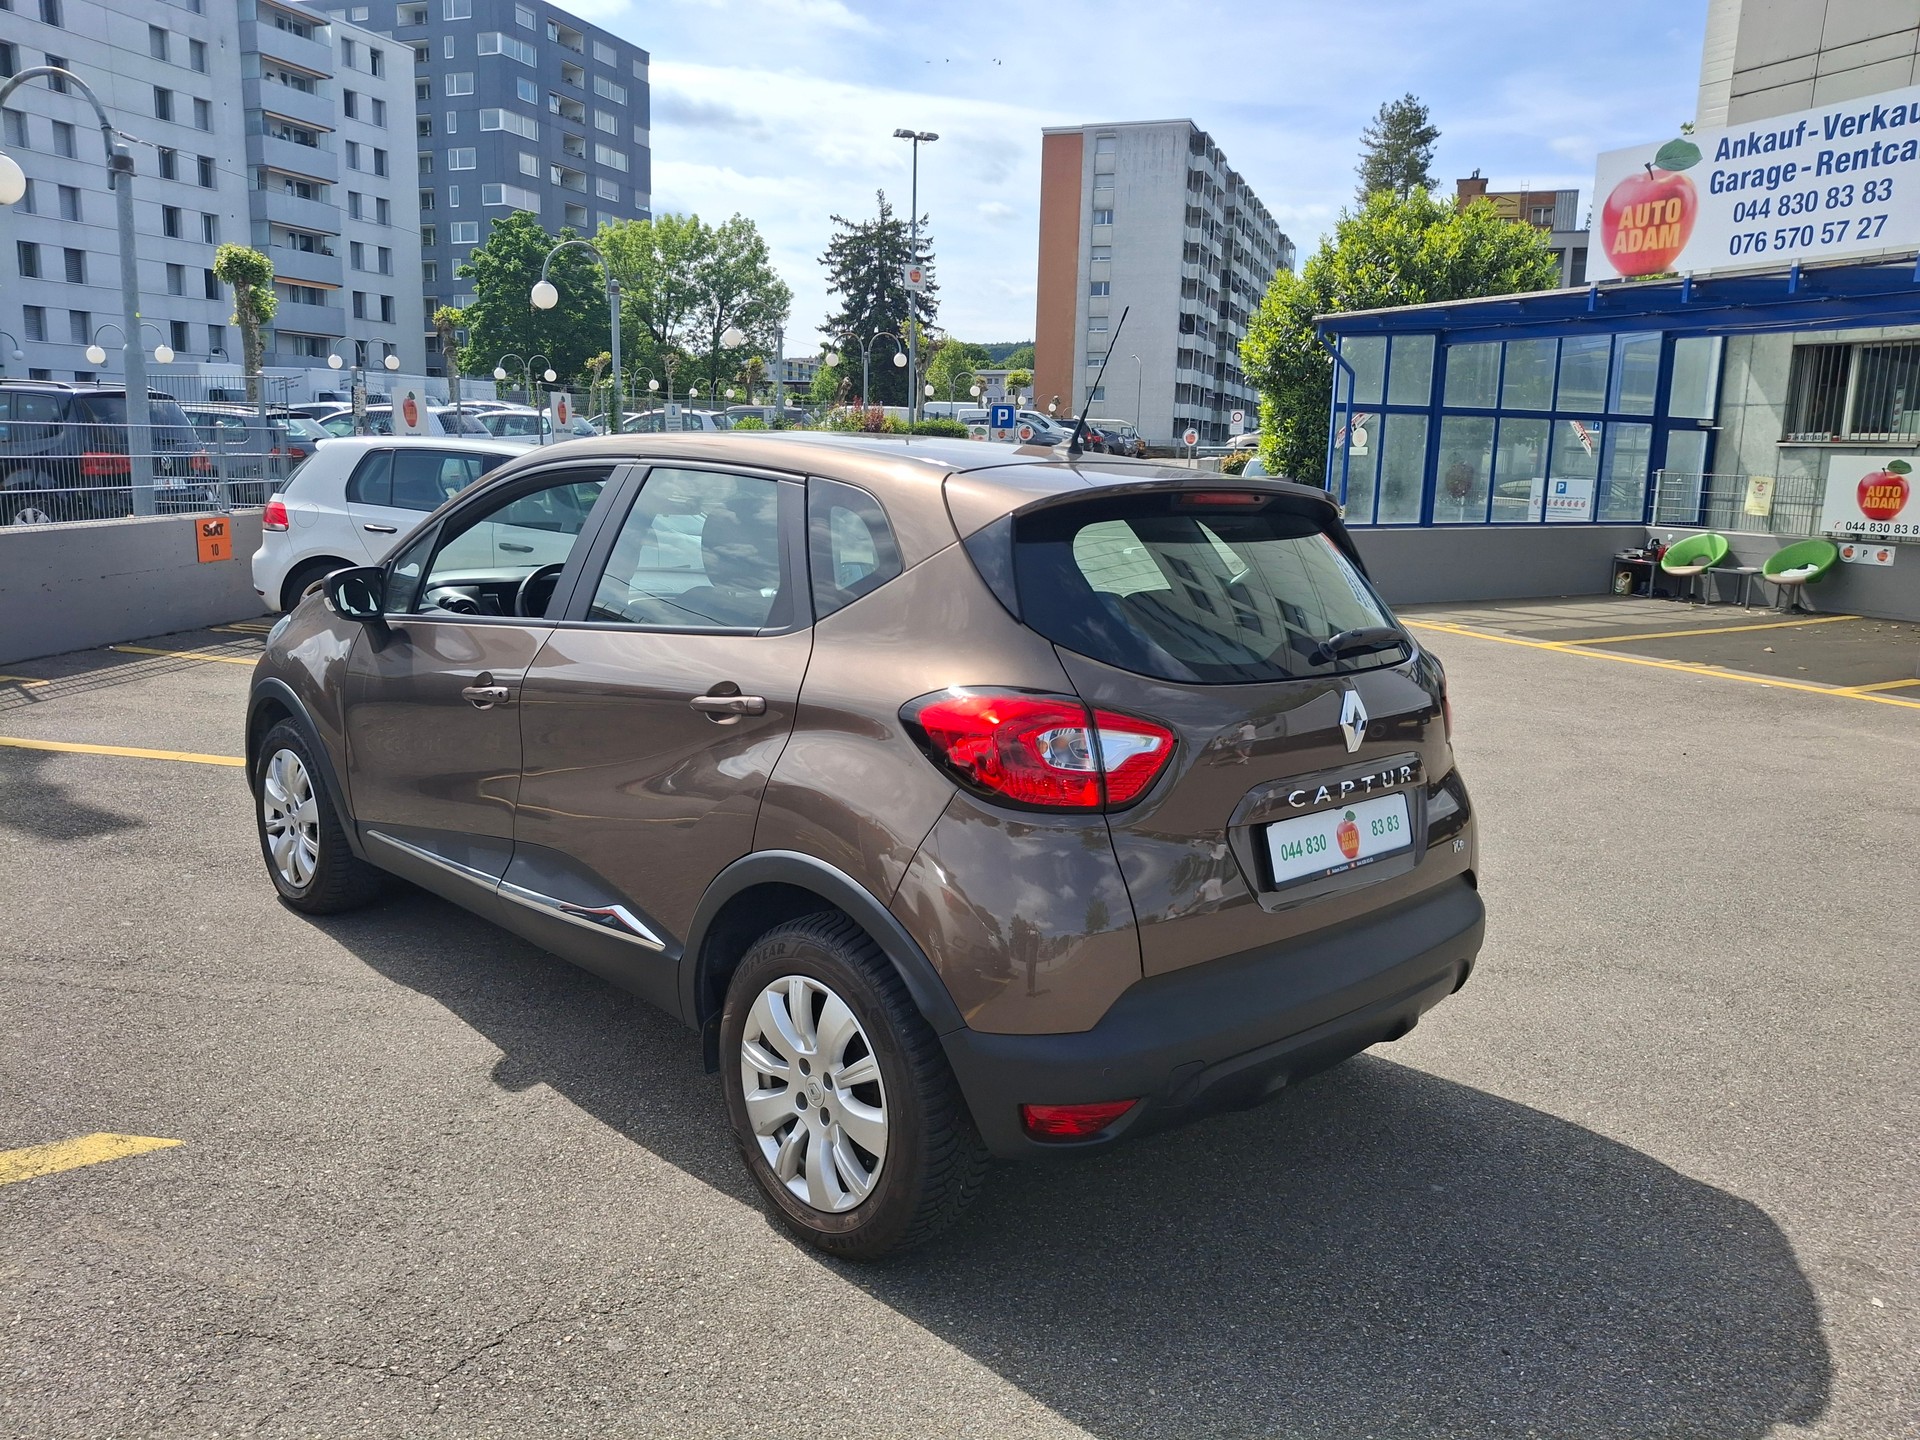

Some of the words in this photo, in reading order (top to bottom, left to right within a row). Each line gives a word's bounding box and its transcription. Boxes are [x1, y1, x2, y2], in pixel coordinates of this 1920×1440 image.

[1733, 197, 1771, 223] 044
[1777, 190, 1819, 217] 830
[1825, 184, 1855, 210] 83
[1861, 178, 1893, 204] 83
[1618, 197, 1682, 231] AUTO
[1611, 223, 1681, 255] ADAM
[1729, 231, 1767, 256] 076
[1773, 224, 1814, 250] 570
[1820, 219, 1850, 244] 57
[1856, 214, 1889, 240] 27
[997, 409, 1009, 426] P
[1557, 483, 1565, 492] P
[1866, 486, 1902, 498] AUTO
[1862, 497, 1900, 509] ADAM
[203, 523, 224, 537] SIXT
[1845, 521, 1865, 531] 044
[1869, 522, 1890, 533] 830
[1893, 523, 1908, 534] 83
[211, 543, 219, 556] 10
[1288, 766, 1412, 808] CAPTUR
[1281, 840, 1303, 861] 044
[1305, 834, 1327, 855] 830
[1371, 818, 1384, 836] 83
[1386, 814, 1400, 832] 83
